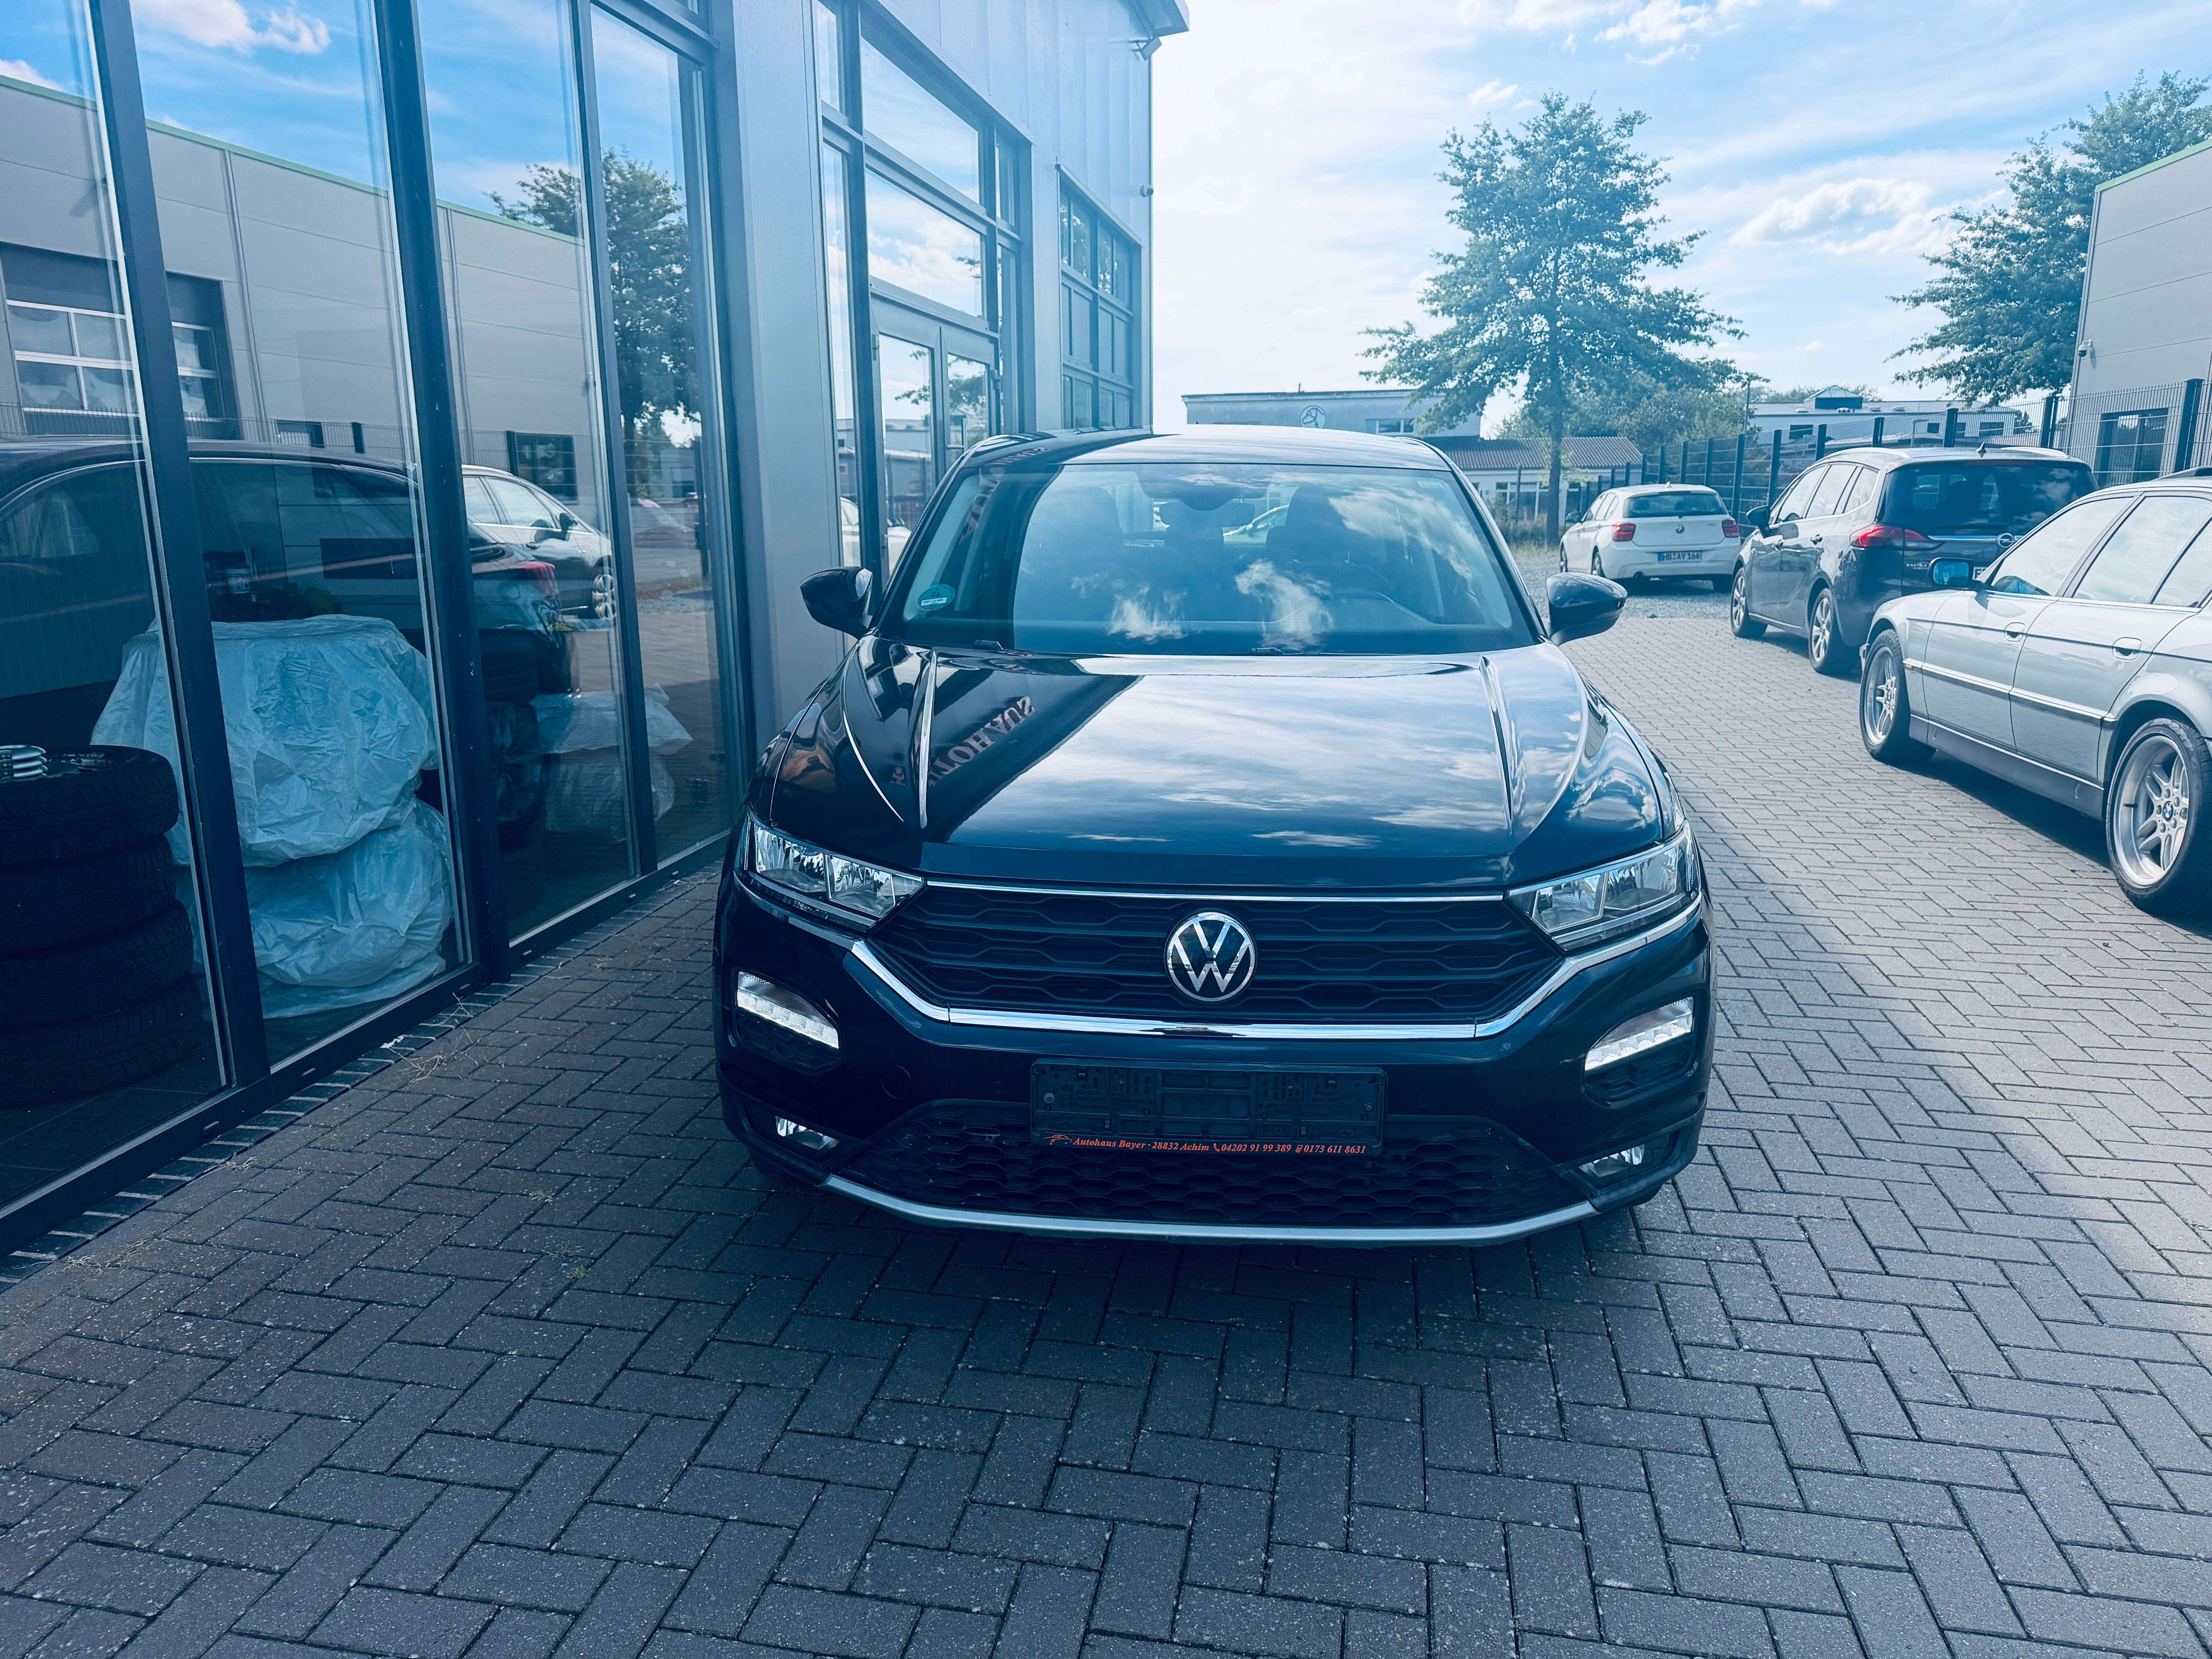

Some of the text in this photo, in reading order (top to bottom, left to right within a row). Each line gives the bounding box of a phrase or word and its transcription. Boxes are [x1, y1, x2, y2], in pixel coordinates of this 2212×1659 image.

[1677, 552, 1686, 560] AY
[1687, 552, 1700, 560] 166
[1073, 1138, 1116, 1147] Autohaus
[1118, 1140, 1146, 1150] Bayer
[1152, 1142, 1179, 1150] 28832
[1221, 1144, 1247, 1152] 04202
[1304, 1145, 1325, 1153] 0173
